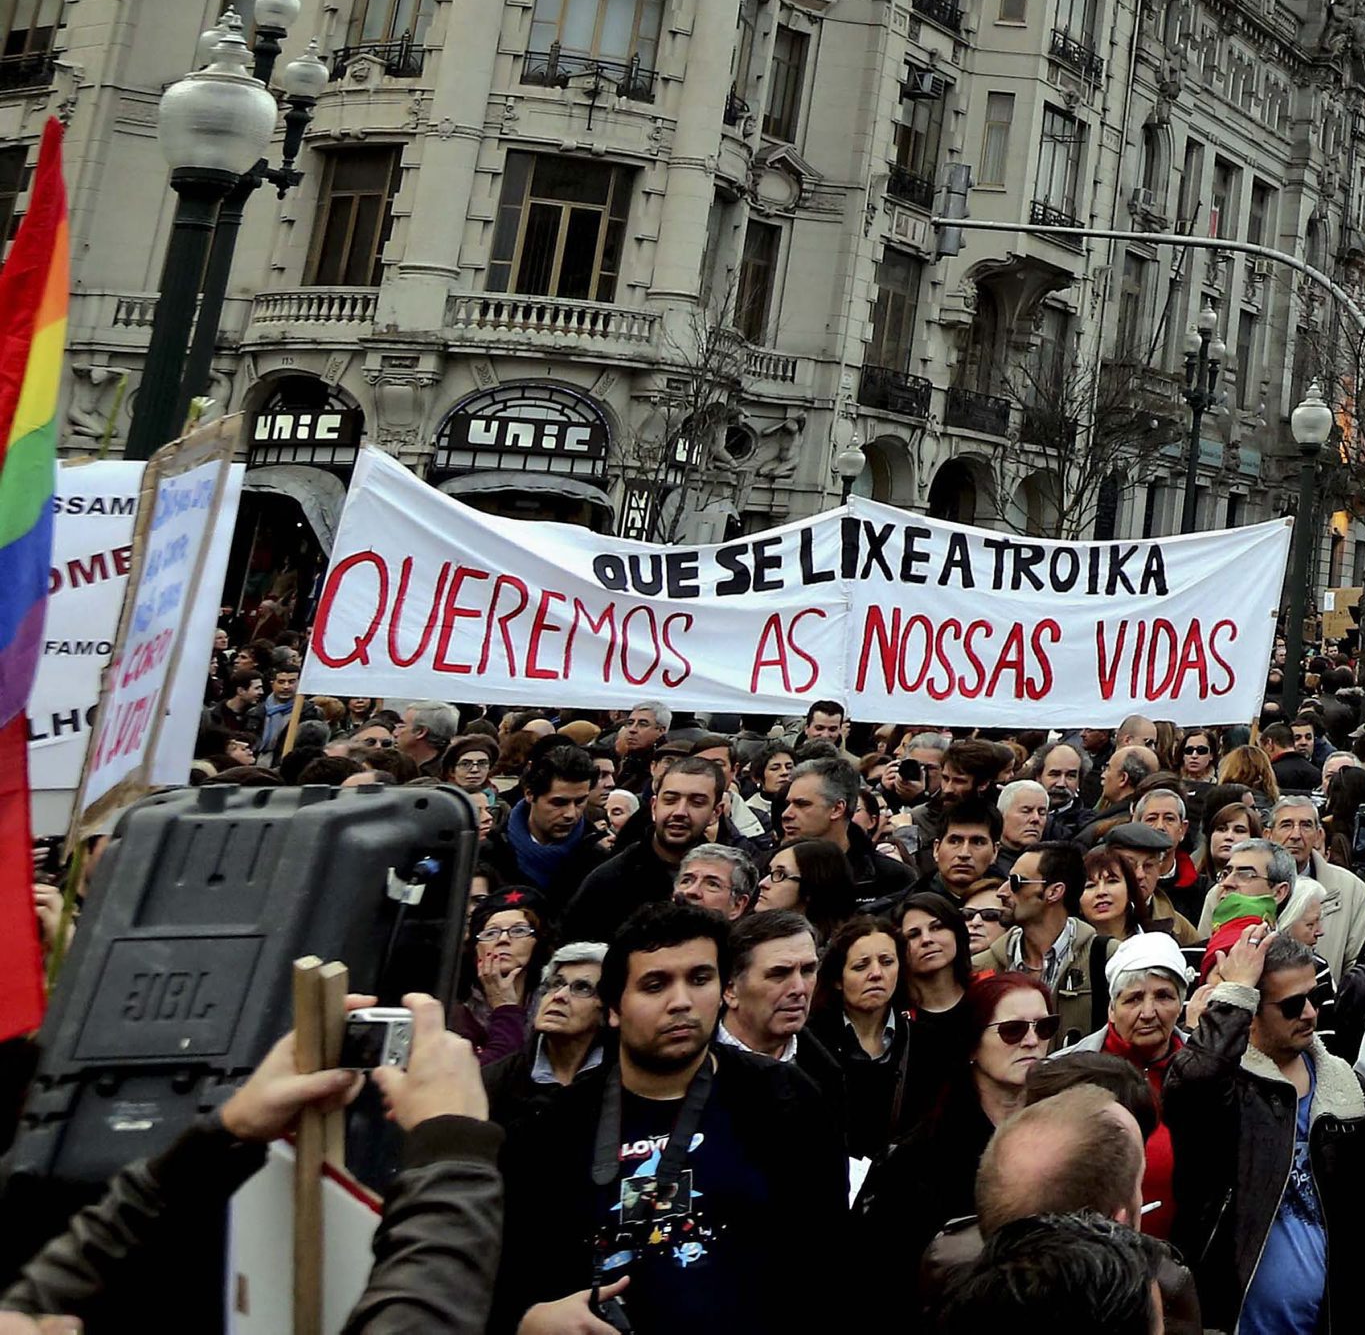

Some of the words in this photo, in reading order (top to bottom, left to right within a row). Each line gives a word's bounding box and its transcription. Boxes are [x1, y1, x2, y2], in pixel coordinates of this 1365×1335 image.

[593, 552, 699, 598] QUE
[715, 536, 784, 597] SE
[801, 517, 932, 586] LIXE
[938, 532, 975, 589] A
[984, 538, 1169, 596] TROIKA
[311, 549, 694, 688] QUEREMOS
[750, 607, 827, 694] AS
[855, 604, 1062, 701] NOSSAS
[1097, 618, 1237, 701] VIDAS
